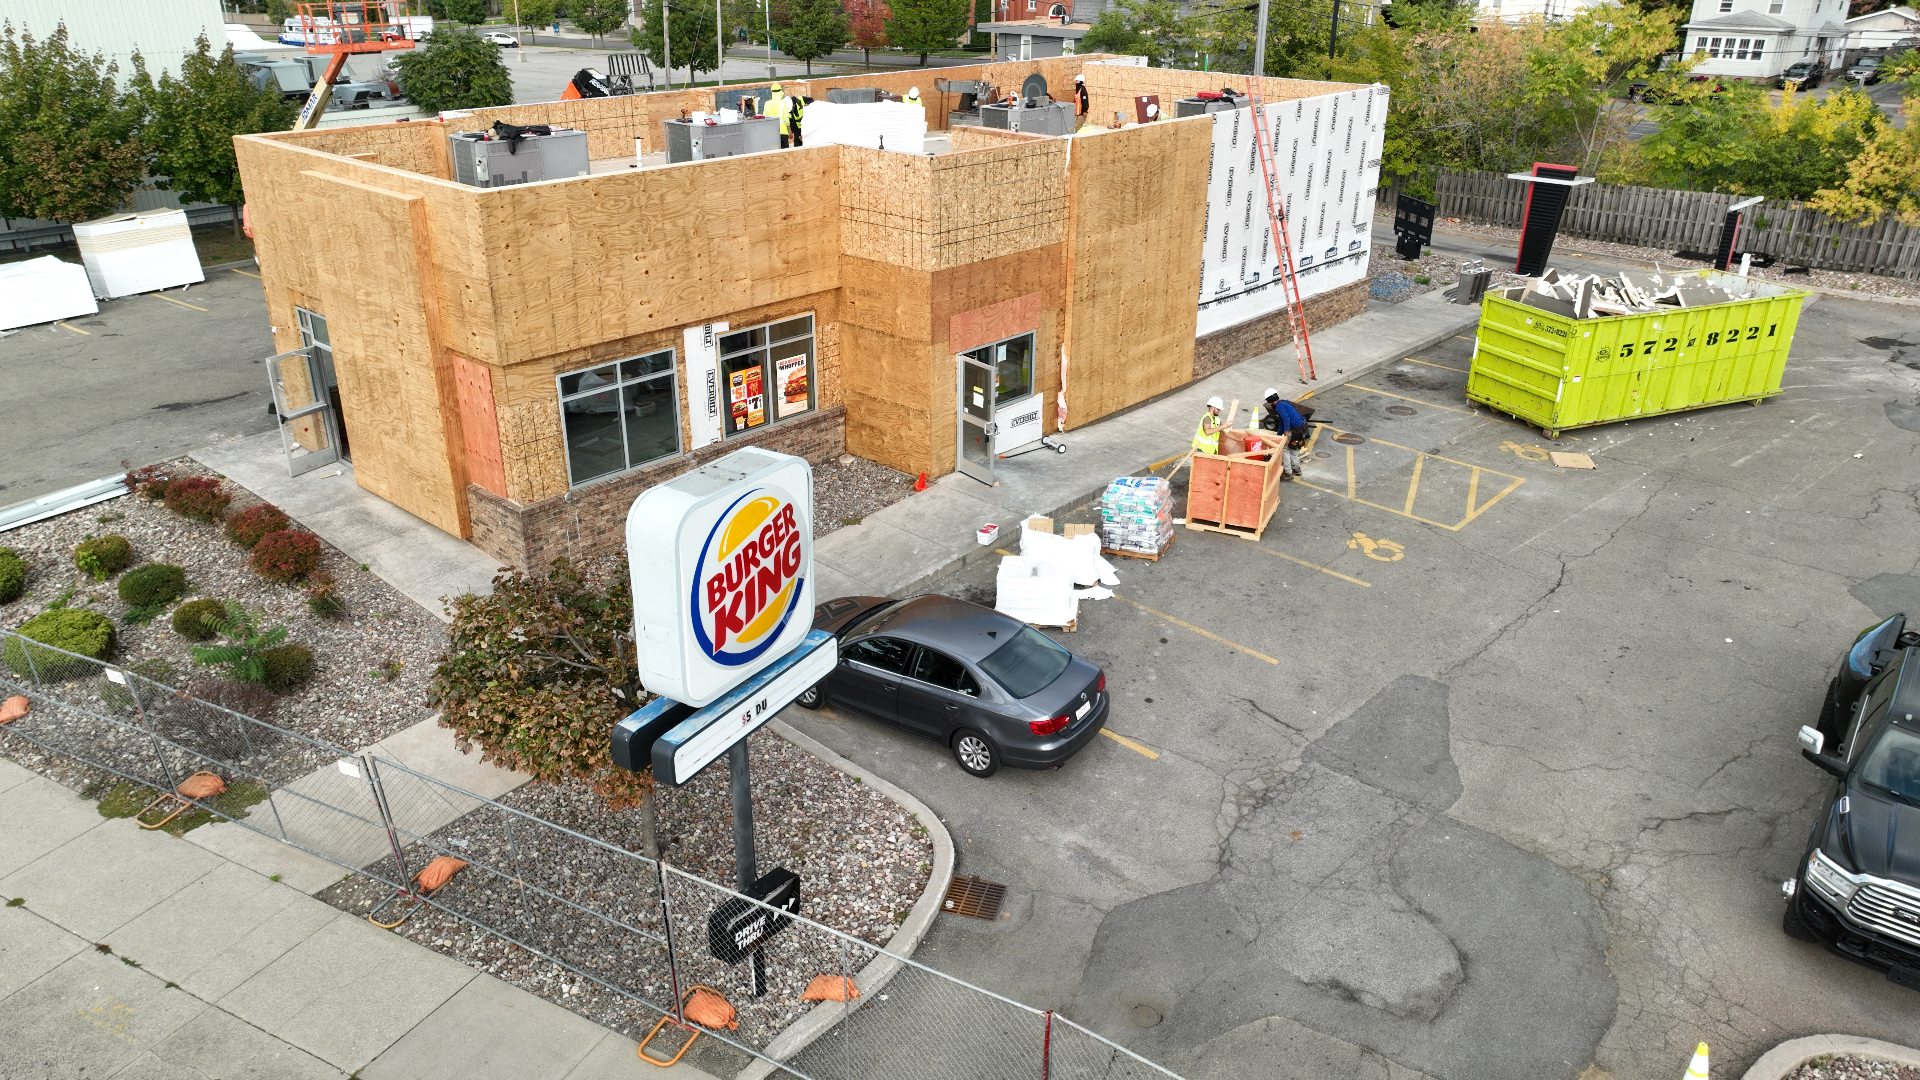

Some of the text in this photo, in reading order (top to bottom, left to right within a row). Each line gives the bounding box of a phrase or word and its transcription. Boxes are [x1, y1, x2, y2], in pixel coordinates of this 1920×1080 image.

[706, 502, 797, 614] BURGER
[713, 530, 801, 655] KING
[741, 698, 768, 726] $5 DU
[735, 915, 766, 942] DRIVE
[737, 927, 764, 950] THRU
